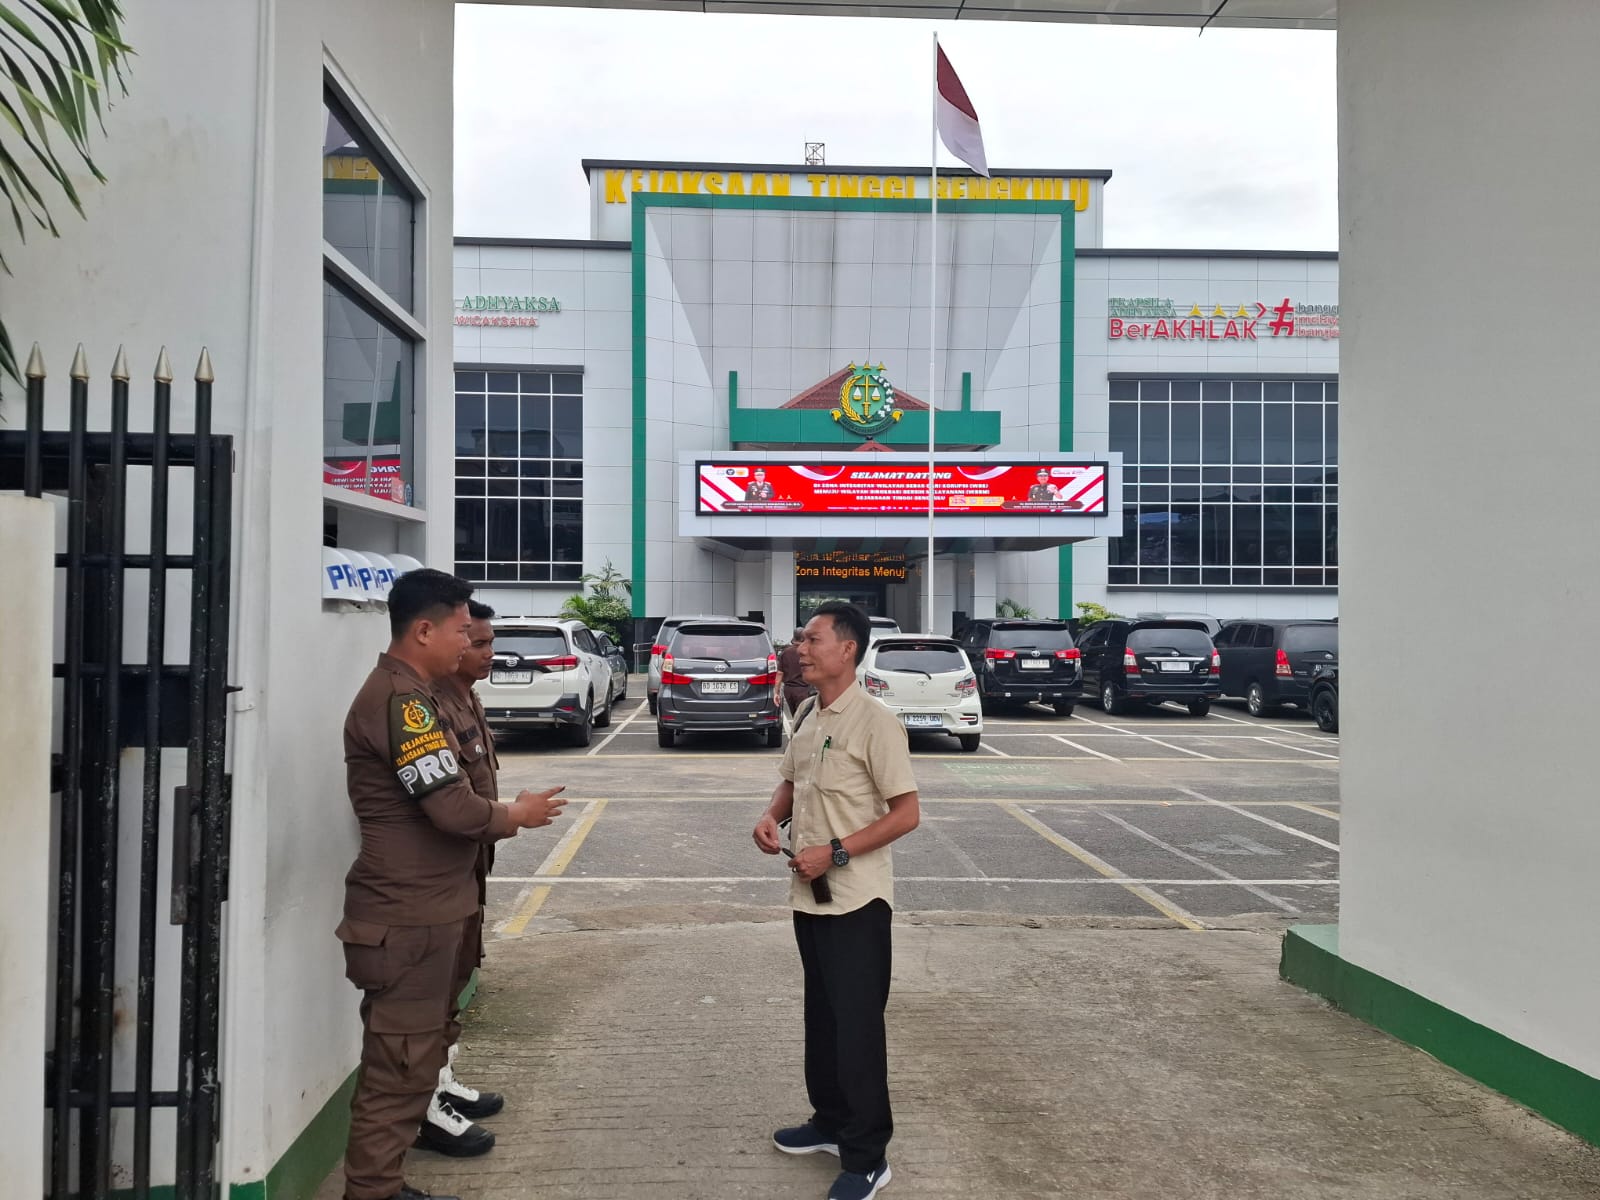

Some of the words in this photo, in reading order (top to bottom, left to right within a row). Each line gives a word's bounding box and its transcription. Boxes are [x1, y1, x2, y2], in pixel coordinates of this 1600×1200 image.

[807, 173, 915, 199] TINGGI
[462, 295, 560, 312] ADHYAKSA
[1109, 317, 1257, 339] BerAKHLAK
[796, 565, 819, 576] Zona
[822, 565, 871, 579] Integritas
[873, 565, 905, 579] Menuj
